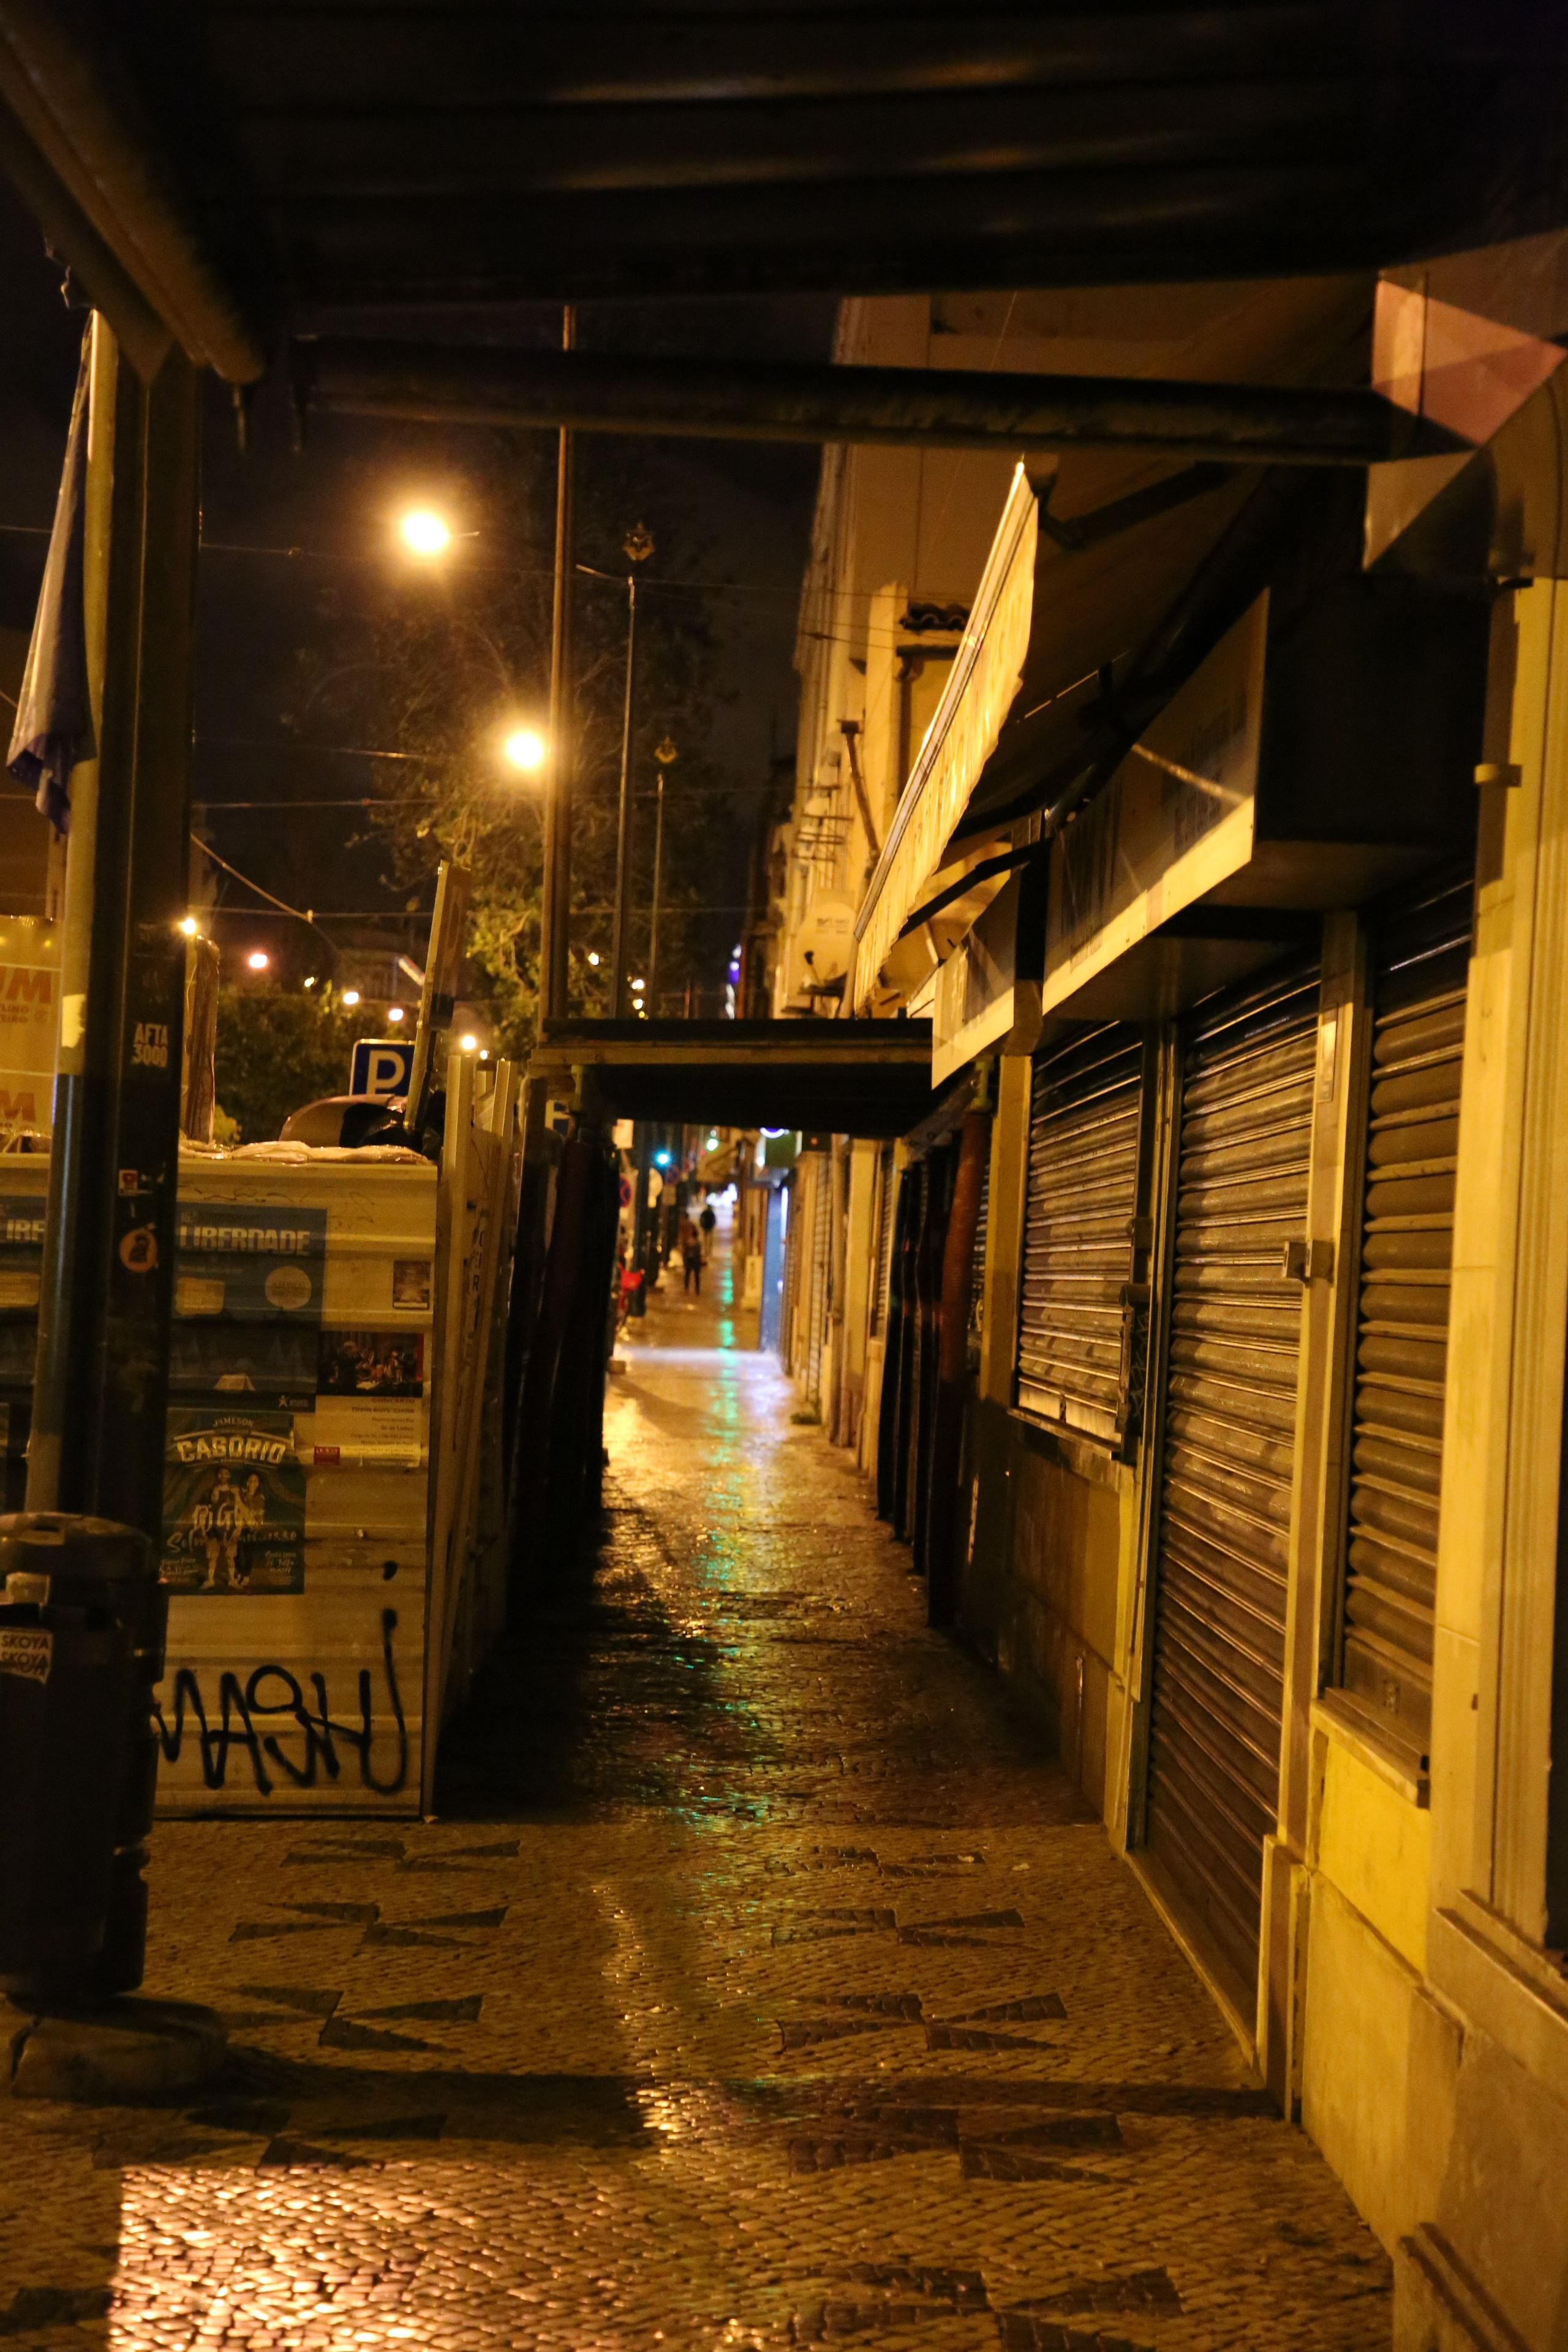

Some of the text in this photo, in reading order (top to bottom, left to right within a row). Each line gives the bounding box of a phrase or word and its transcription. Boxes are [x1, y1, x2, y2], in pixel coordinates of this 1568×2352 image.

[133, 1023, 169, 1044] AFTA
[130, 1044, 168, 1068] 3000
[366, 1050, 404, 1095] P
[179, 1225, 310, 1256] LIBERDADE
[2, 1635, 49, 1649] SKOYA
